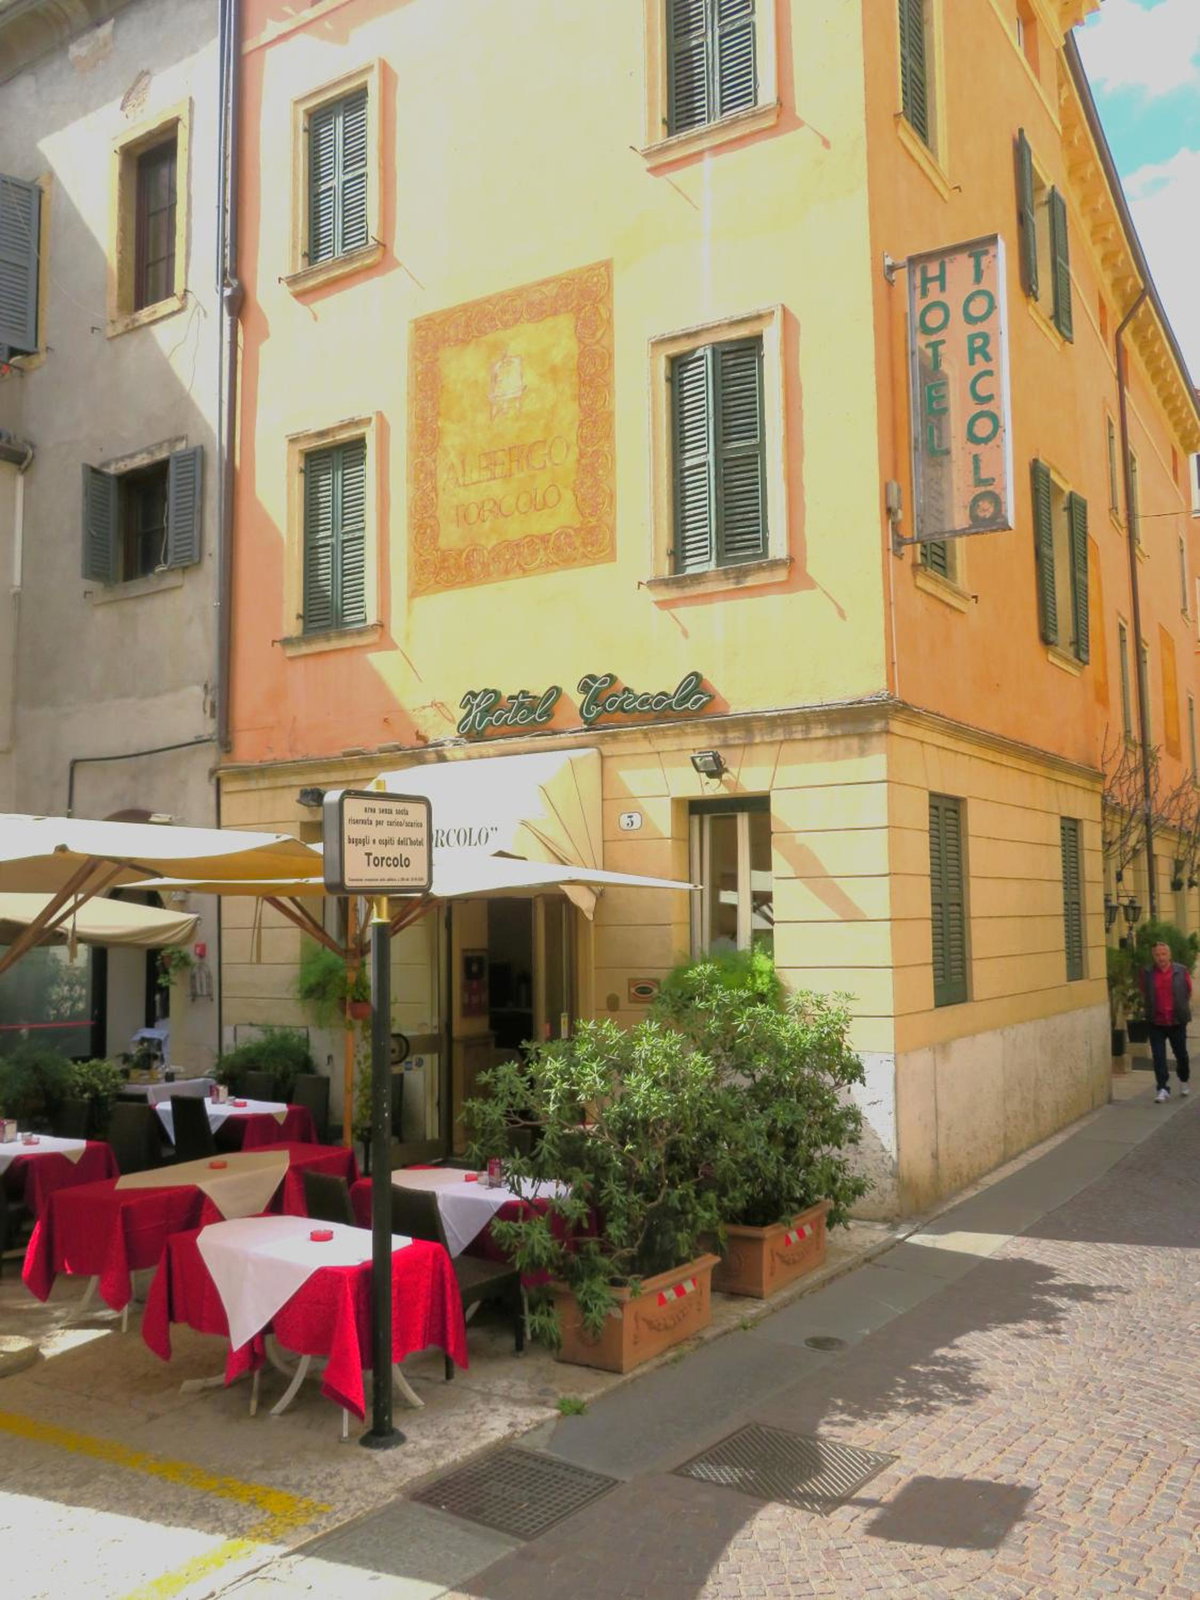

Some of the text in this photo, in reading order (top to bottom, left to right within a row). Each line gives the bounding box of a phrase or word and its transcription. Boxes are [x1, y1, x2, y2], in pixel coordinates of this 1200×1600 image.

[919, 259, 950, 457] HOTEL
[962, 249, 1001, 529] TORCOLO
[444, 435, 570, 491] ALBERGO
[454, 484, 562, 528] TORCOLO
[457, 671, 715, 736] Hotel Torcolo
[348, 817, 423, 829] riservata per carico/scarico
[379, 807, 393, 815] senza
[395, 808, 409, 816] sosta
[347, 835, 370, 847] bagagli
[378, 836, 395, 848] ospiti
[397, 836, 424, 847] dell'hotel
[364, 852, 411, 868] Torcolo
